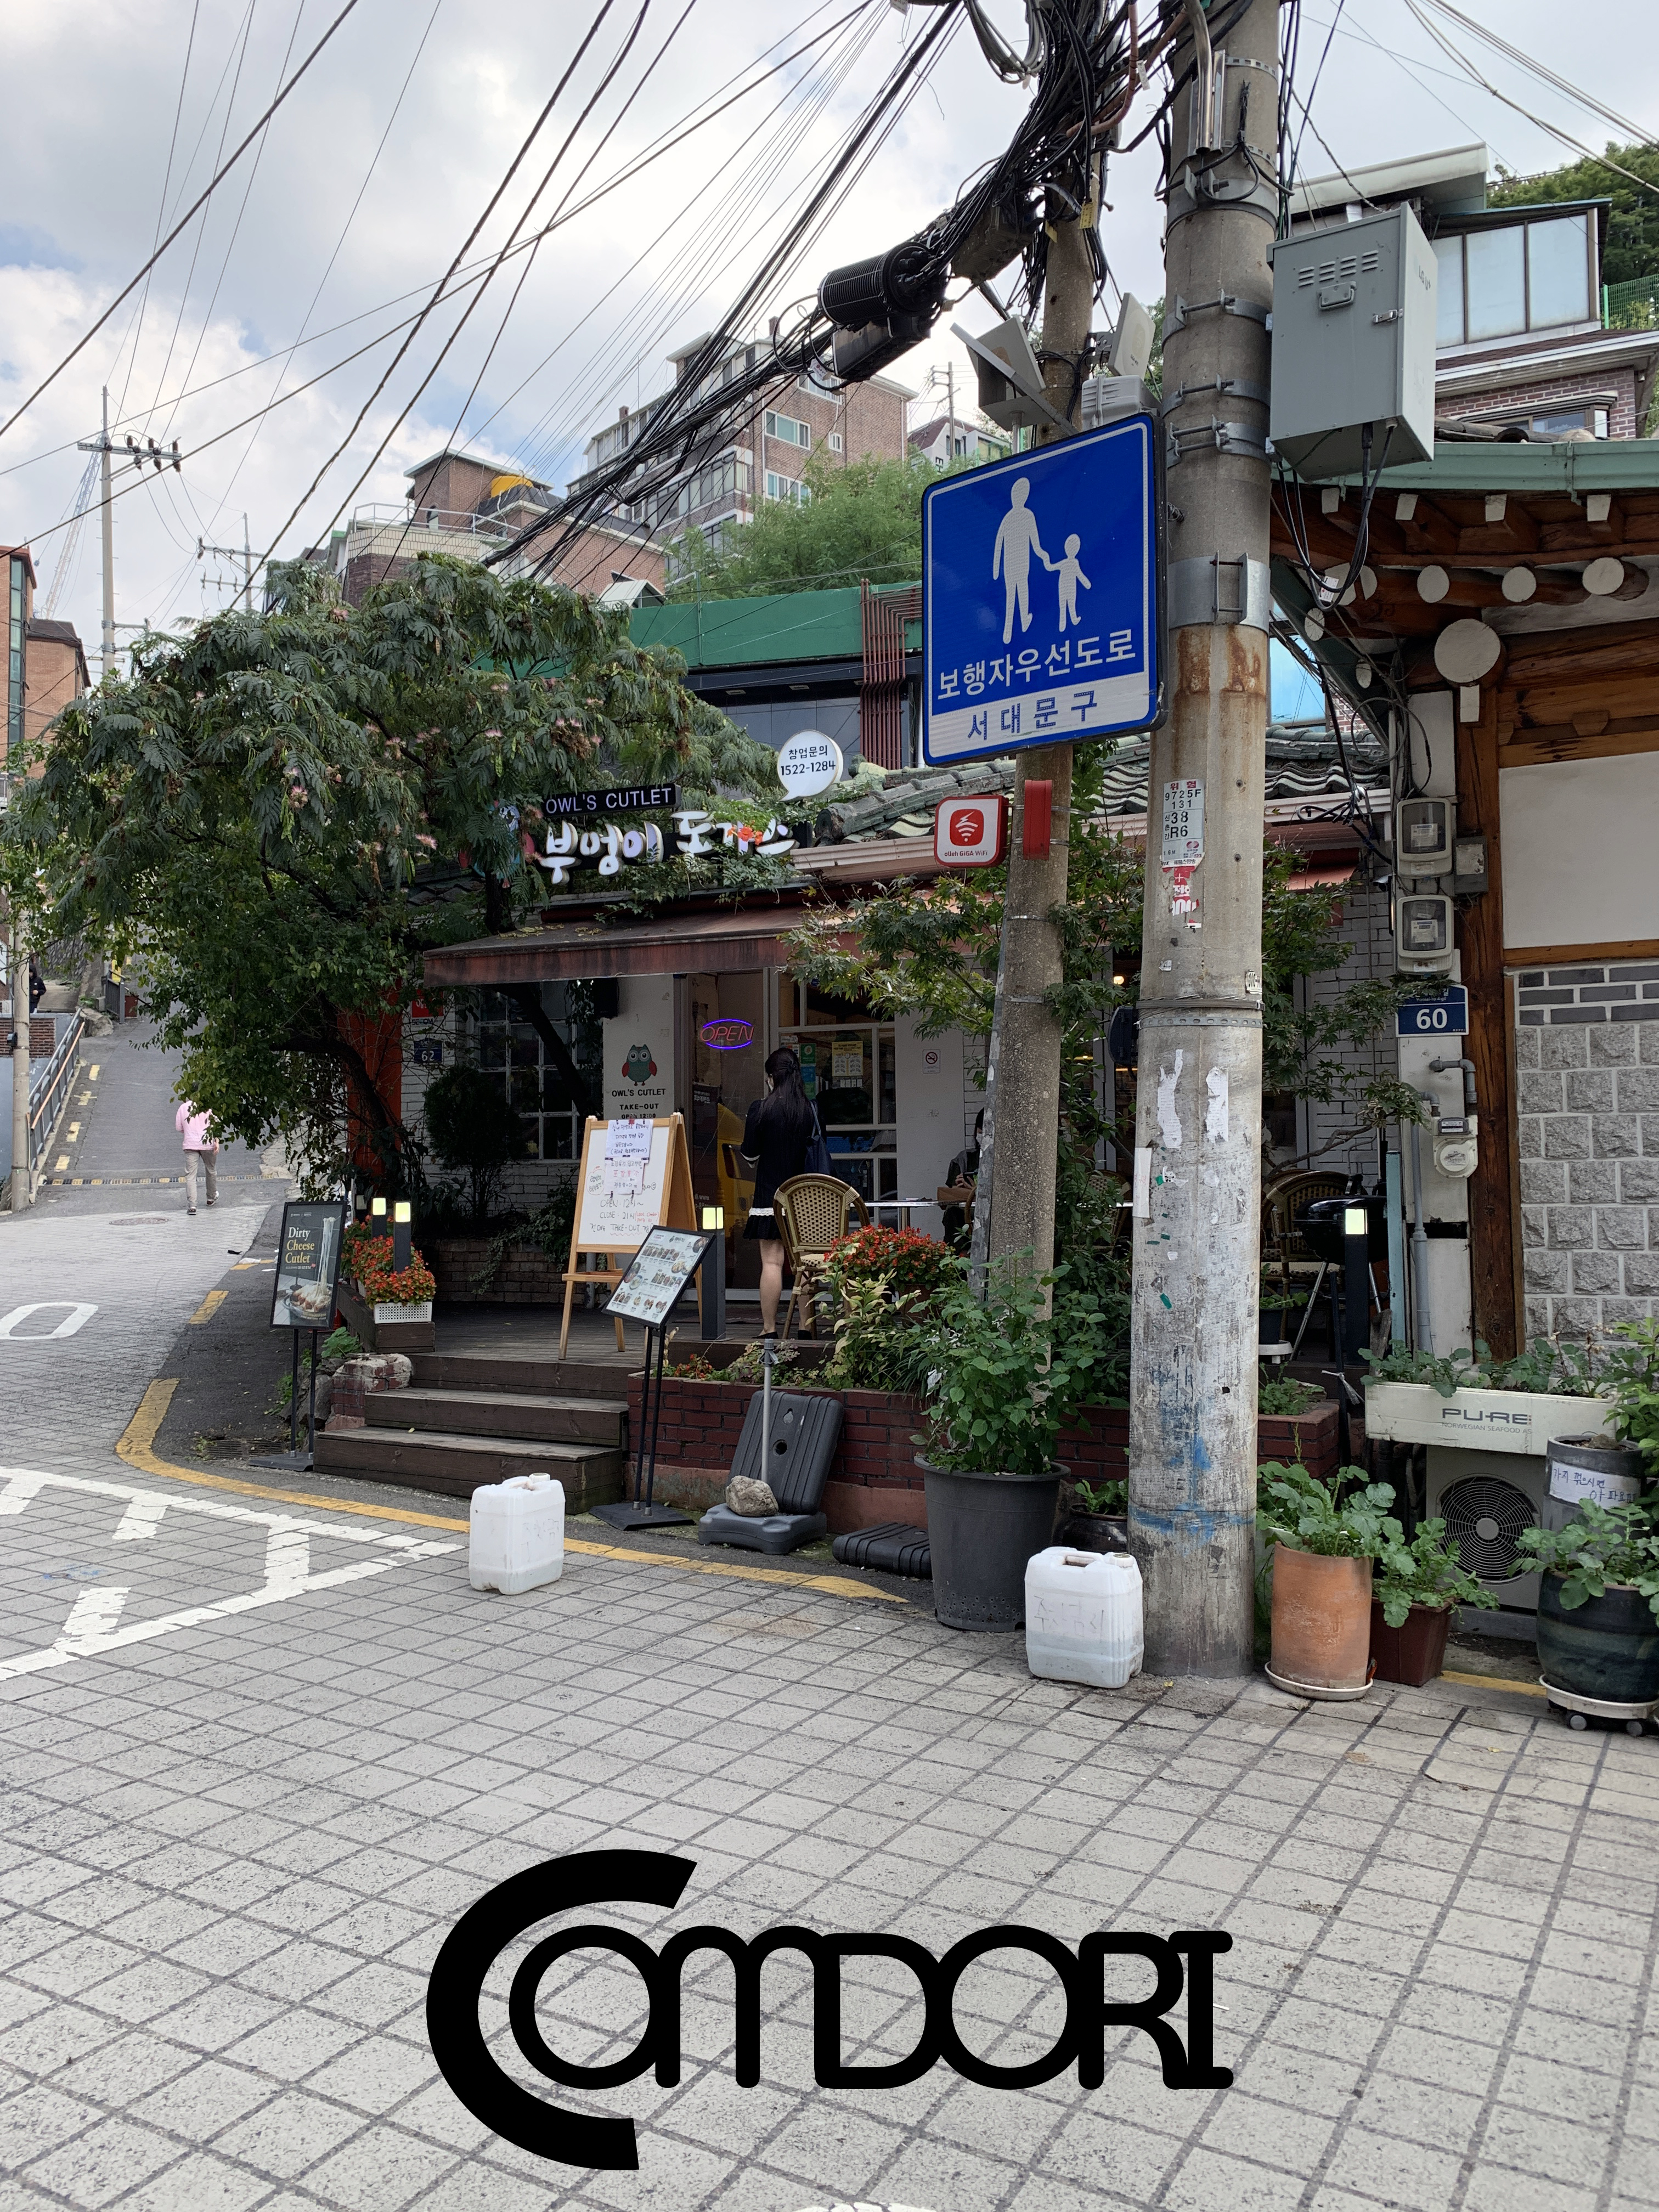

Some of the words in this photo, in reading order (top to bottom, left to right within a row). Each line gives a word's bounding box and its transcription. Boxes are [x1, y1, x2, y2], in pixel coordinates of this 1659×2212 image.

[938, 629, 1136, 700] 보행자우선도로
[967, 690, 1098, 741] 서대문구
[788, 744, 828, 761] 창업문의
[780, 760, 837, 776] 1522-1284
[1170, 780, 1197, 791] 위험
[545, 793, 596, 814] OWL'S
[605, 788, 672, 809] CUTLET
[1165, 789, 1201, 801] 9725F
[1171, 799, 1192, 809] 131
[1171, 811, 1189, 824] 38
[1170, 825, 1188, 839] R6
[540, 820, 663, 884] 부엉이
[1416, 1008, 1448, 1030] 60
[699, 1025, 754, 1041] OPEN
[421, 1050, 435, 1062] 62
[612, 1089, 634, 1097] OWL'S
[288, 1227, 311, 1241] Dirty
[286, 1239, 315, 1251] Cheese
[285, 1251, 311, 1264] Cutlet
[1442, 1422, 1486, 1431] NORWEGIAN
[1487, 1425, 1520, 1434] SEAFOOD
[1553, 1468, 1568, 1483] 가지
